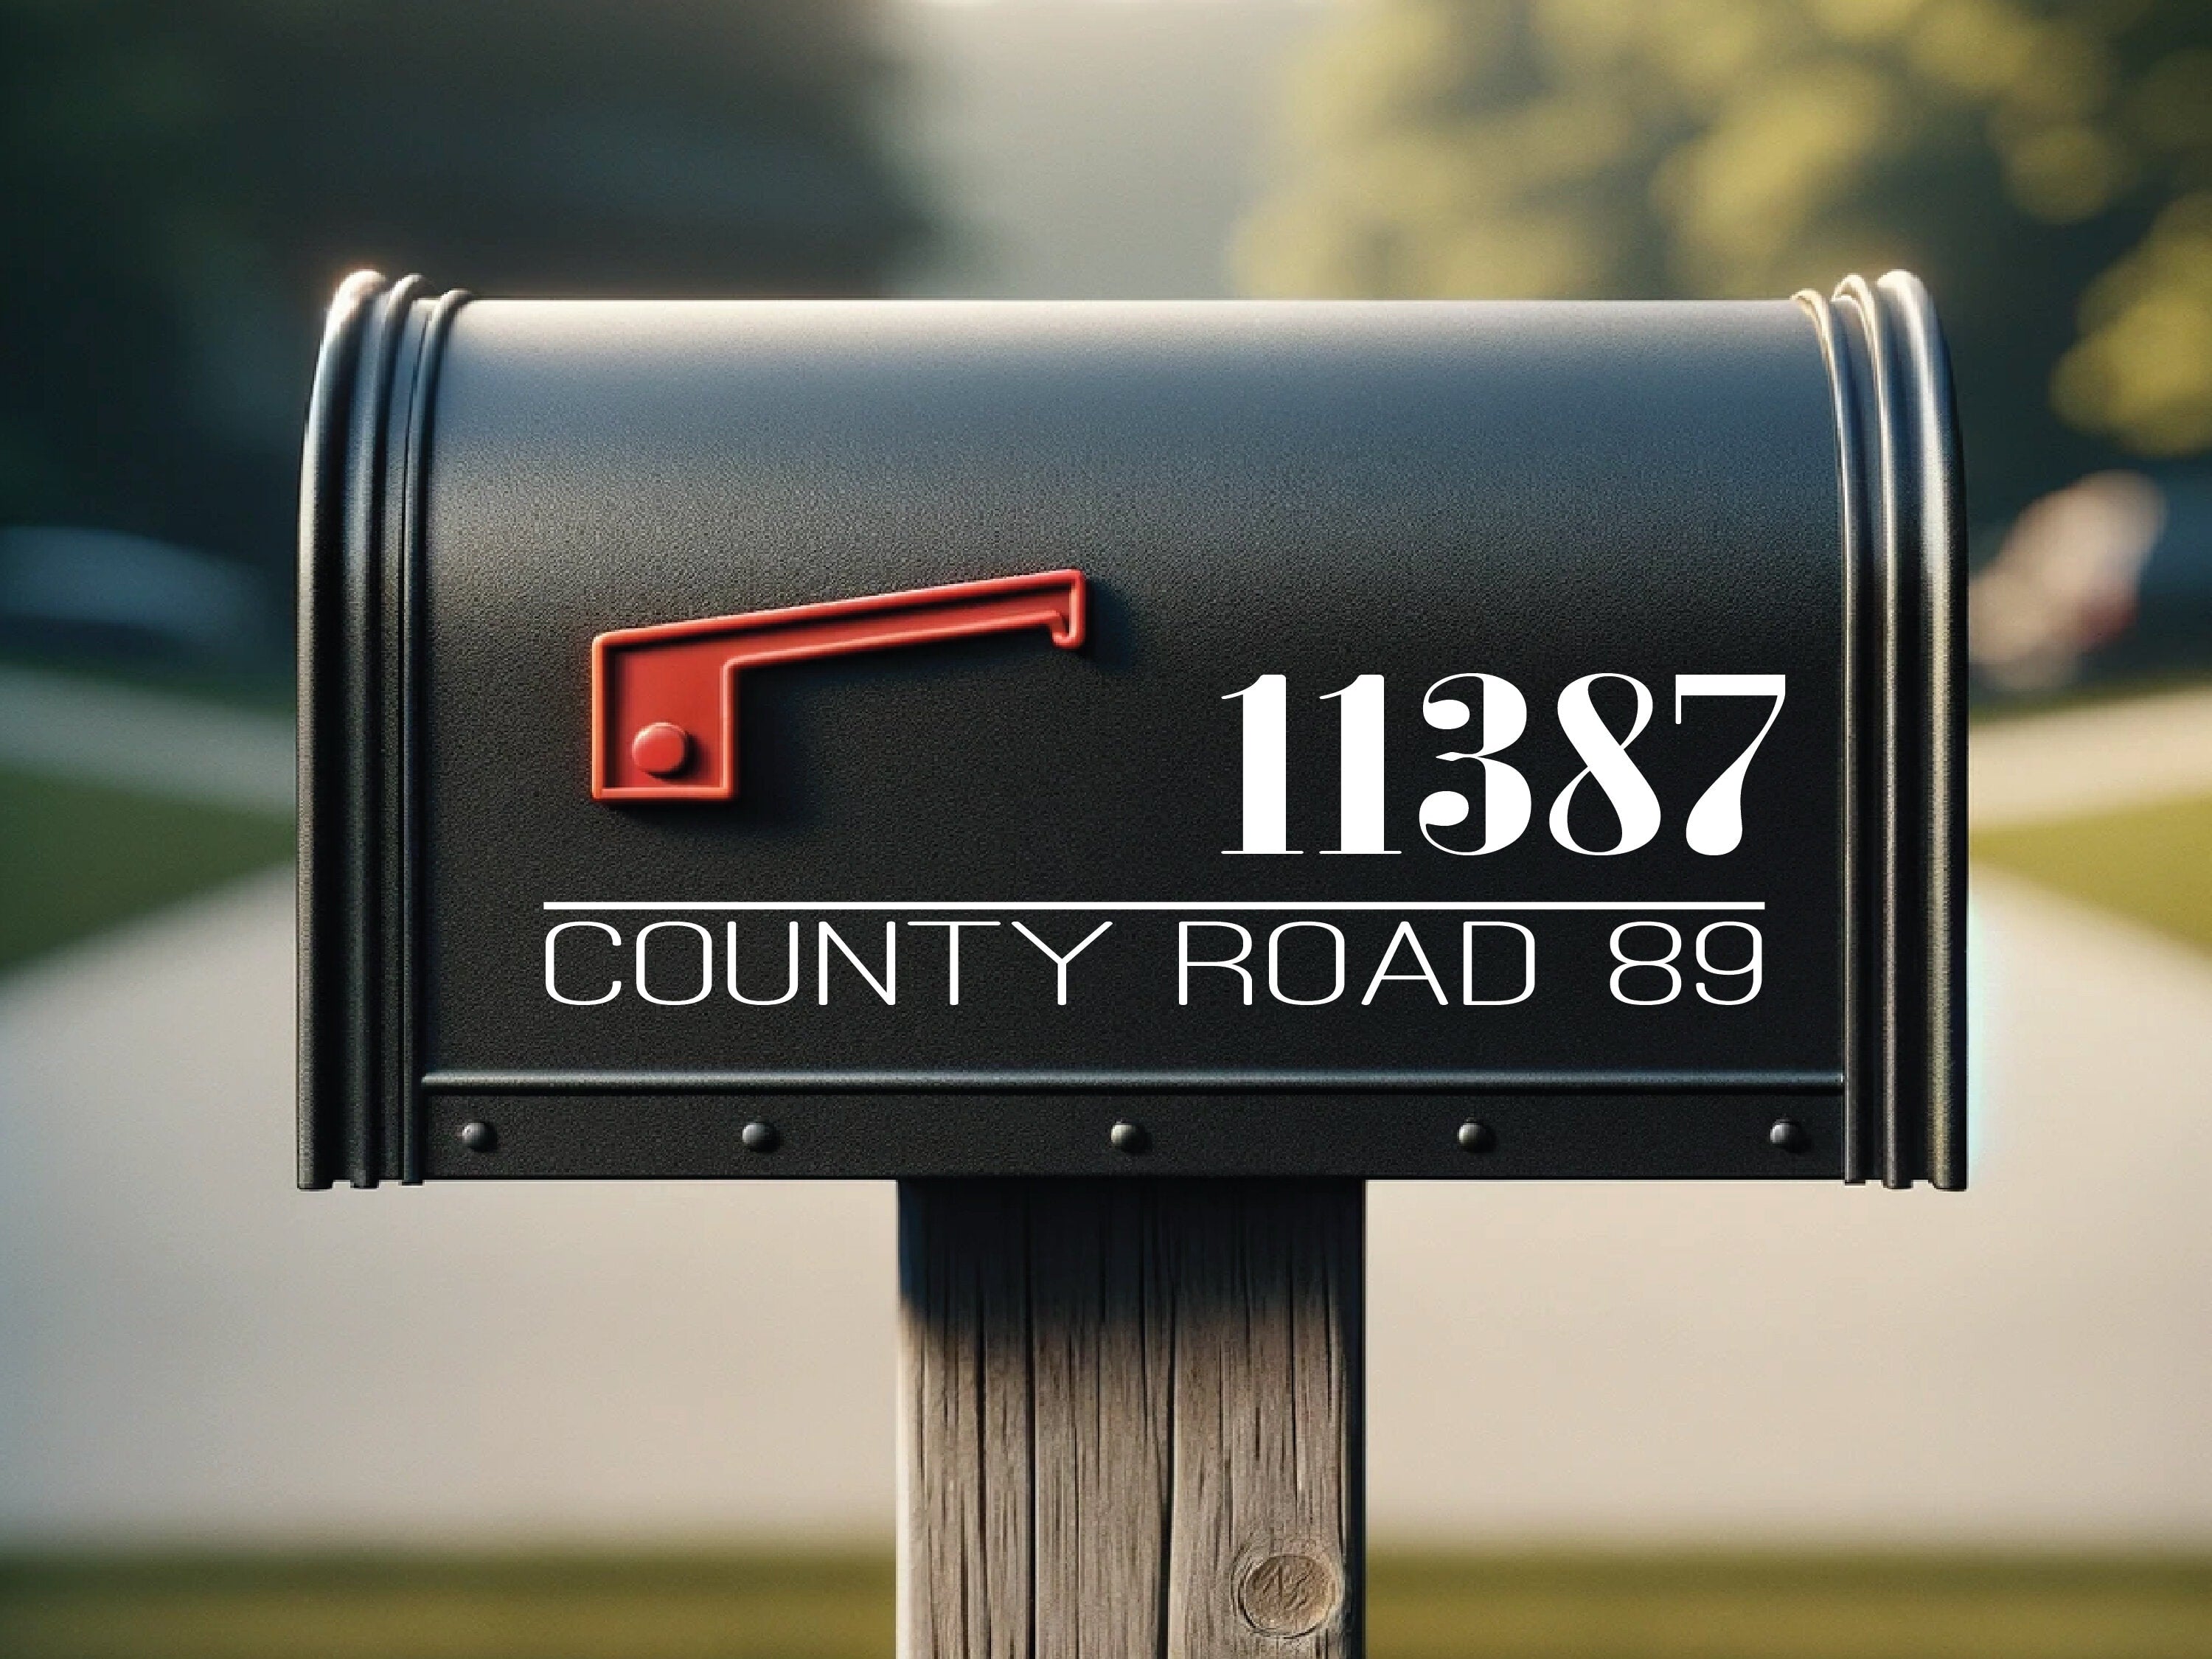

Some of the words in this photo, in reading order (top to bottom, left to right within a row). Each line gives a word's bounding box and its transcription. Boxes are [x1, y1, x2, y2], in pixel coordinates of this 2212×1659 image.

[1220, 672, 1786, 856] 11387
[544, 921, 1113, 1006] COUNTY
[1178, 921, 1536, 1006] ROAD
[1609, 921, 1764, 1006] 89
